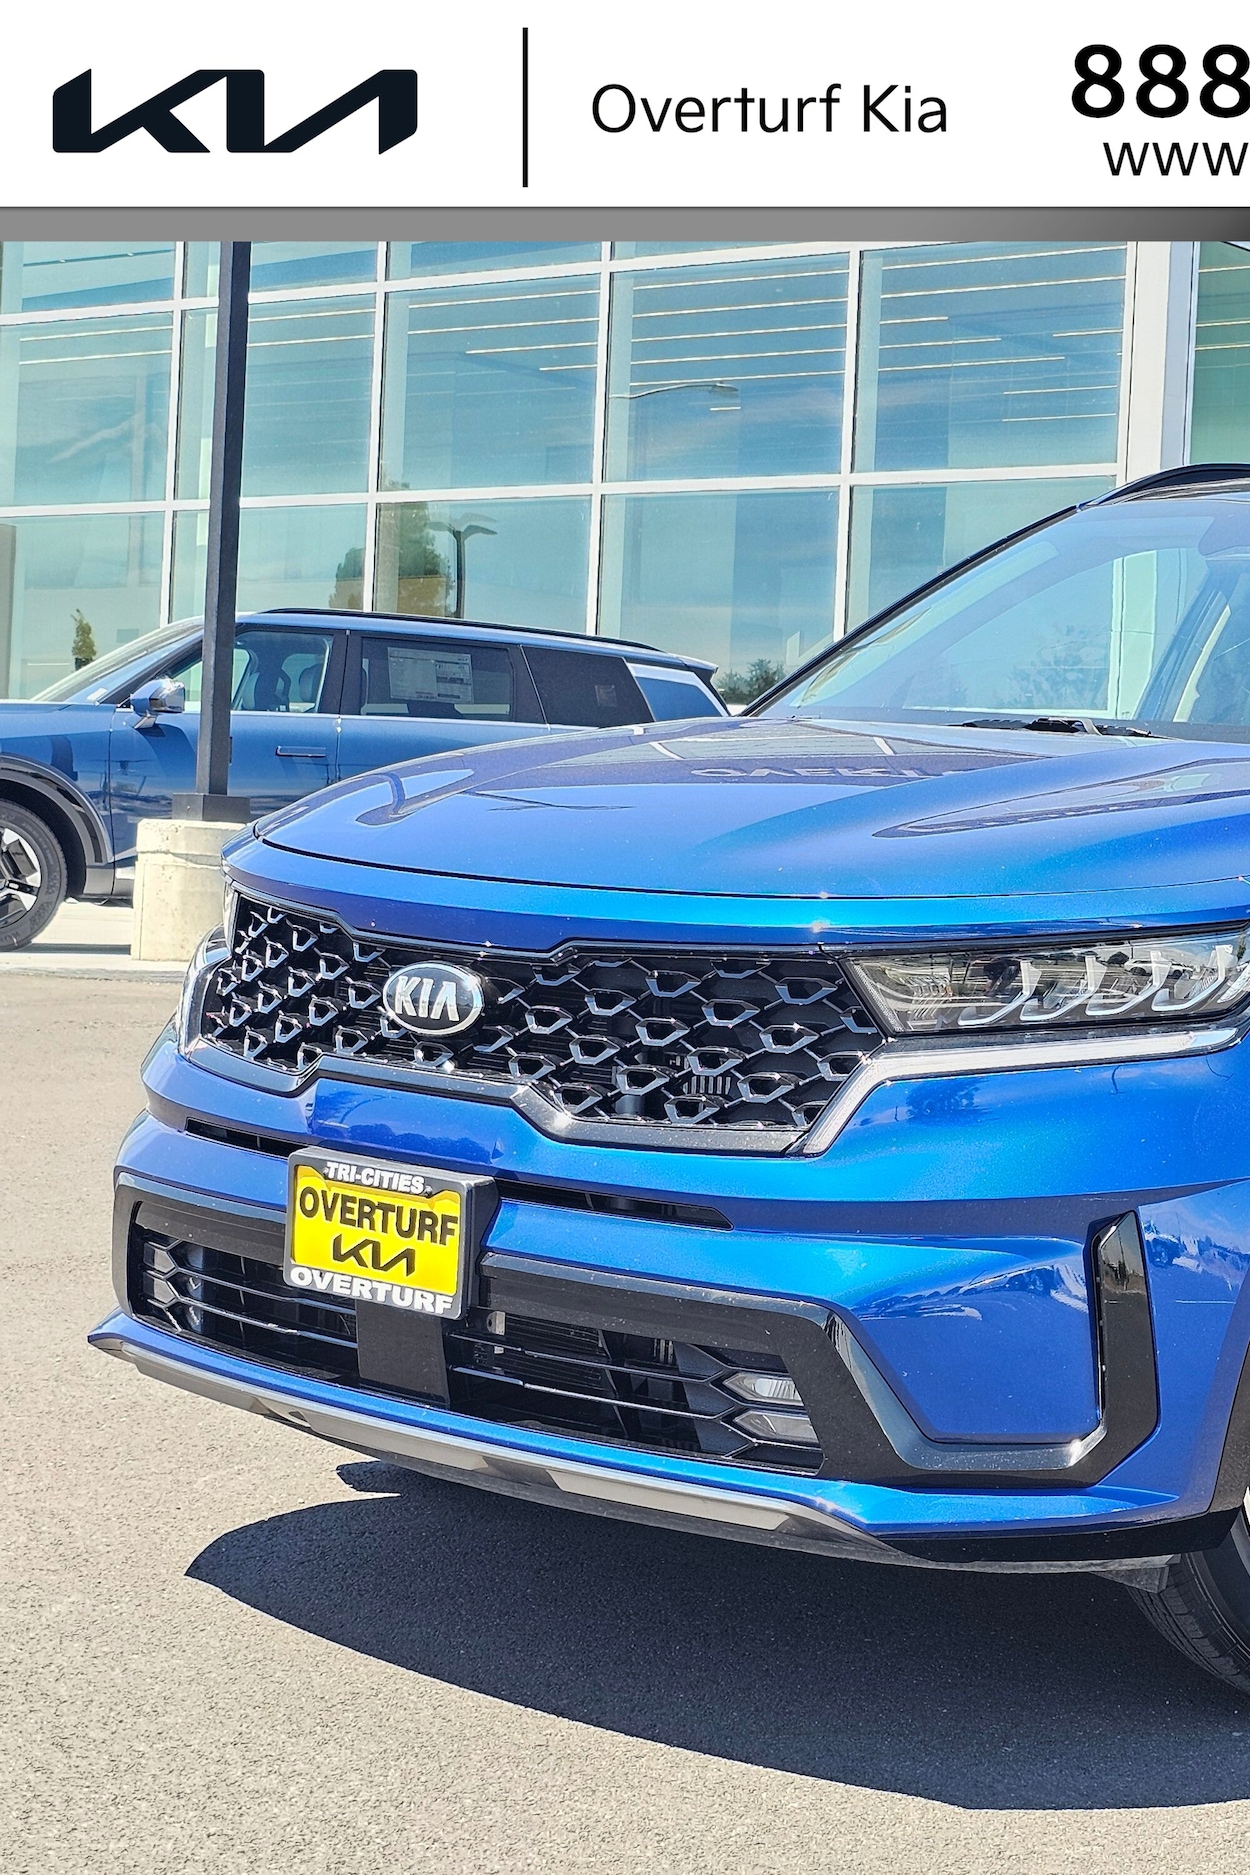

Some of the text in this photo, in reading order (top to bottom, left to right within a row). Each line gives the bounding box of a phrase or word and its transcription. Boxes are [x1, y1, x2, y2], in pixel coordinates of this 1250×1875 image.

[394, 975, 460, 1022] KIA
[327, 1161, 425, 1194] TRI-CITIES
[299, 1186, 459, 1246] OVERTURF
[290, 1267, 453, 1315] OVERTURF
